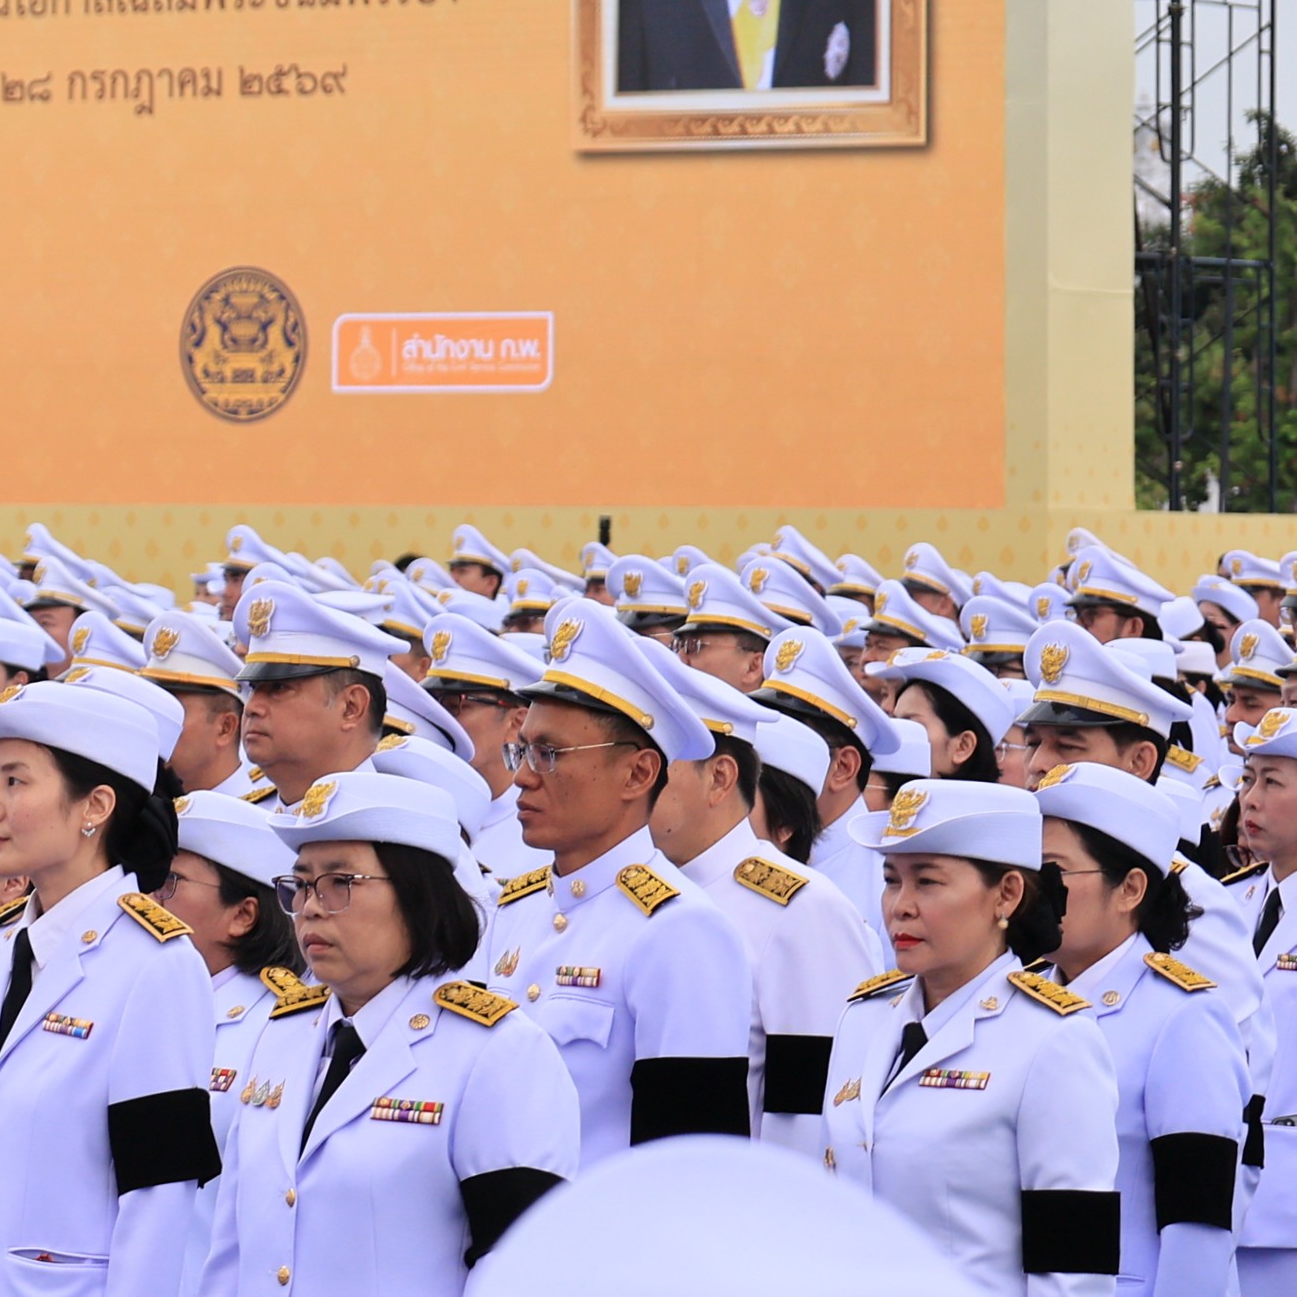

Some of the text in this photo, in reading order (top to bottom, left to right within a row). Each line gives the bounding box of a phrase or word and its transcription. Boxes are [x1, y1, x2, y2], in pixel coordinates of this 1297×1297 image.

[0, 62, 348, 117] ๒๘ กรกฎาคม ๒๕๖๙
[402, 332, 494, 359] สำนักงาน
